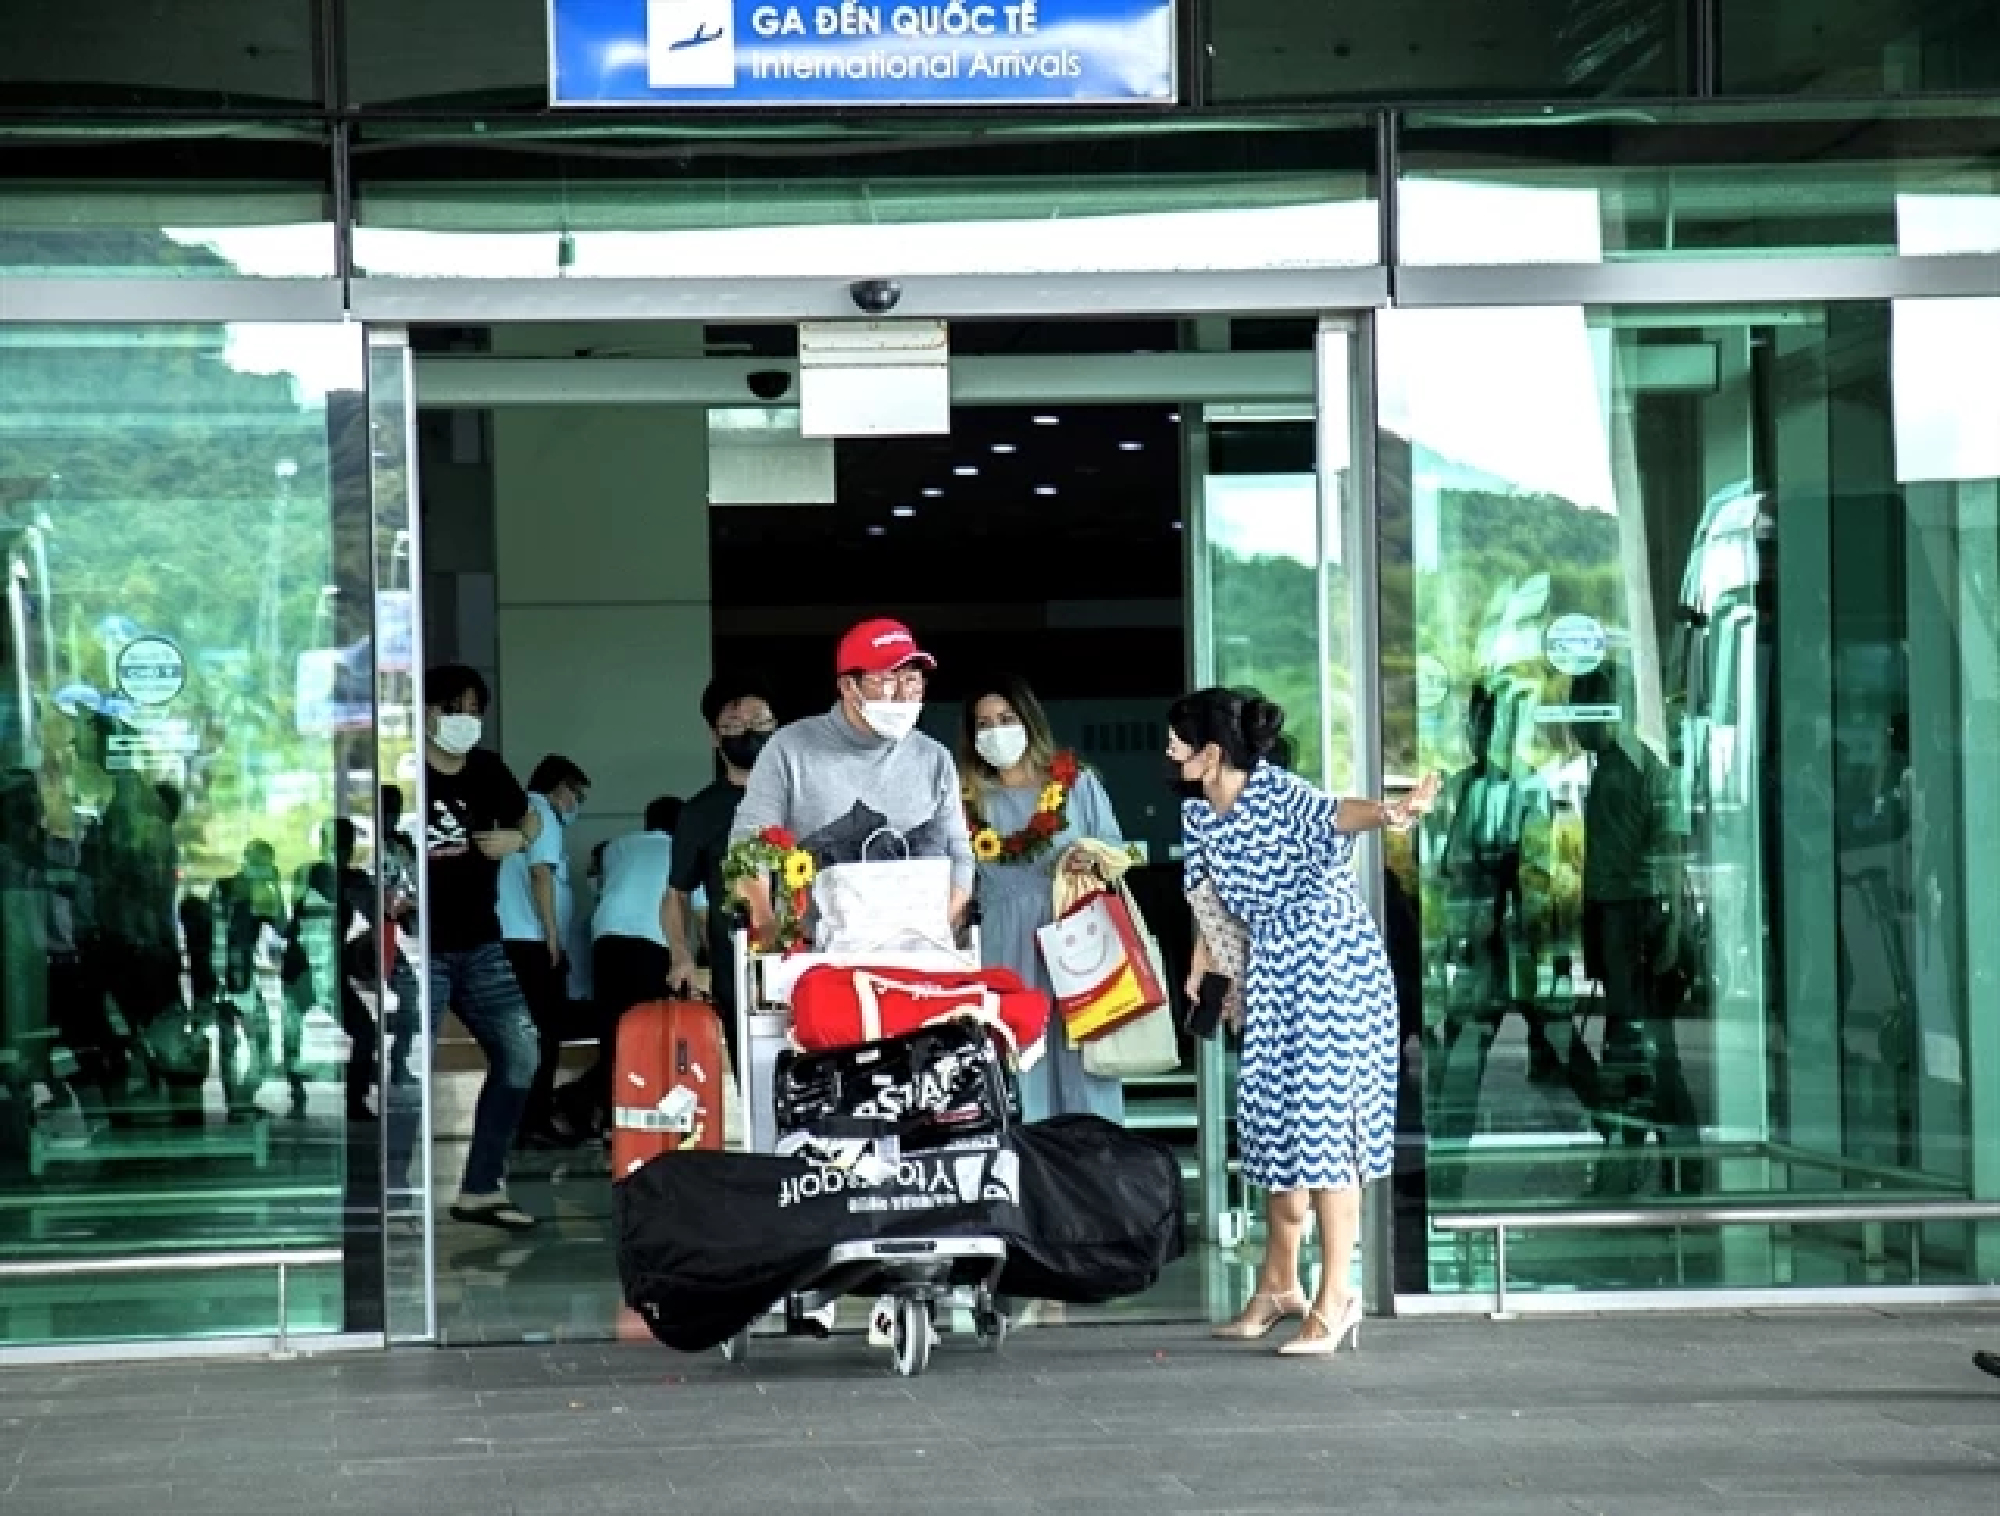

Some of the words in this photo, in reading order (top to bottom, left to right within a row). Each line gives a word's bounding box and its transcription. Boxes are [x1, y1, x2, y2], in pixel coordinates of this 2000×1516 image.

[753, 5, 806, 37] GA
[815, 0, 881, 36] ĐẾN
[890, 0, 995, 37] QUỐC
[1002, 0, 1038, 36] TẾ
[752, 50, 960, 80] International
[968, 50, 1082, 80] Arrivals
